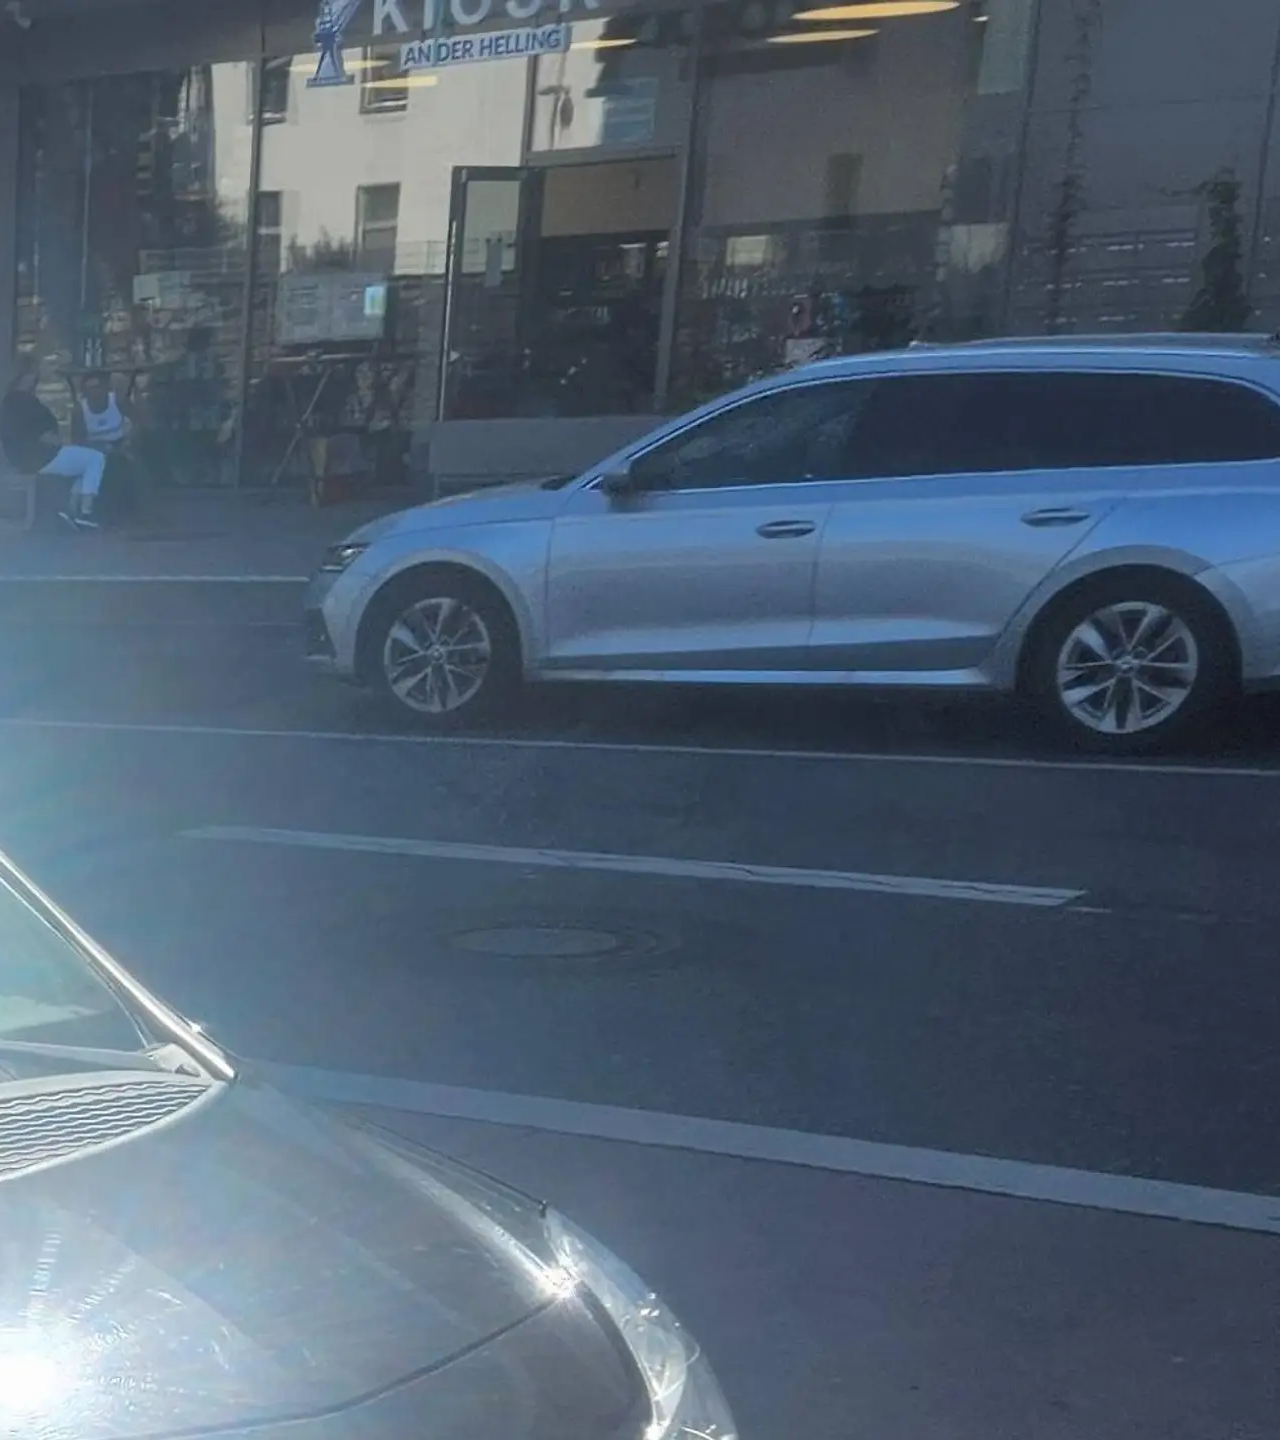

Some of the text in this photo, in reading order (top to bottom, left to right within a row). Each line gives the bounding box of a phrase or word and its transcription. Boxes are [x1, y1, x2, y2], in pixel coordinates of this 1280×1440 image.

[403, 28, 561, 66] AN DER HELLING
